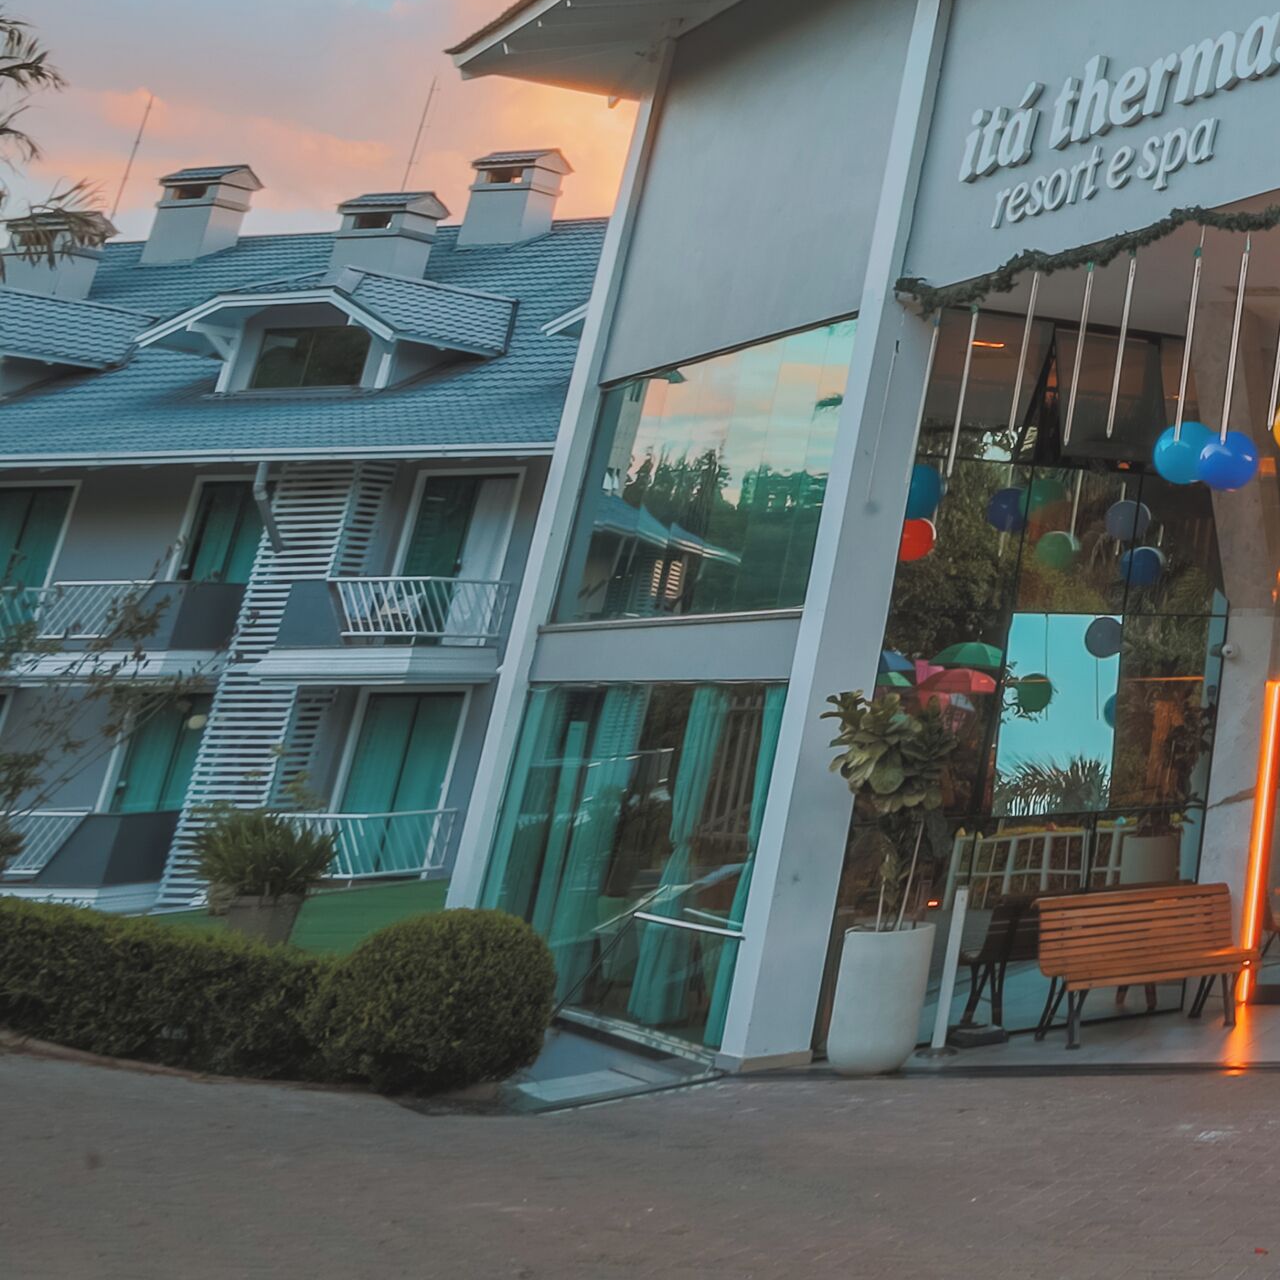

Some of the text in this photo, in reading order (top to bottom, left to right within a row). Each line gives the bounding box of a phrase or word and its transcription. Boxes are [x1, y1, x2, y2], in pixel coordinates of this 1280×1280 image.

[958, 81, 1045, 182] itá
[990, 117, 1219, 228] resort e spa
